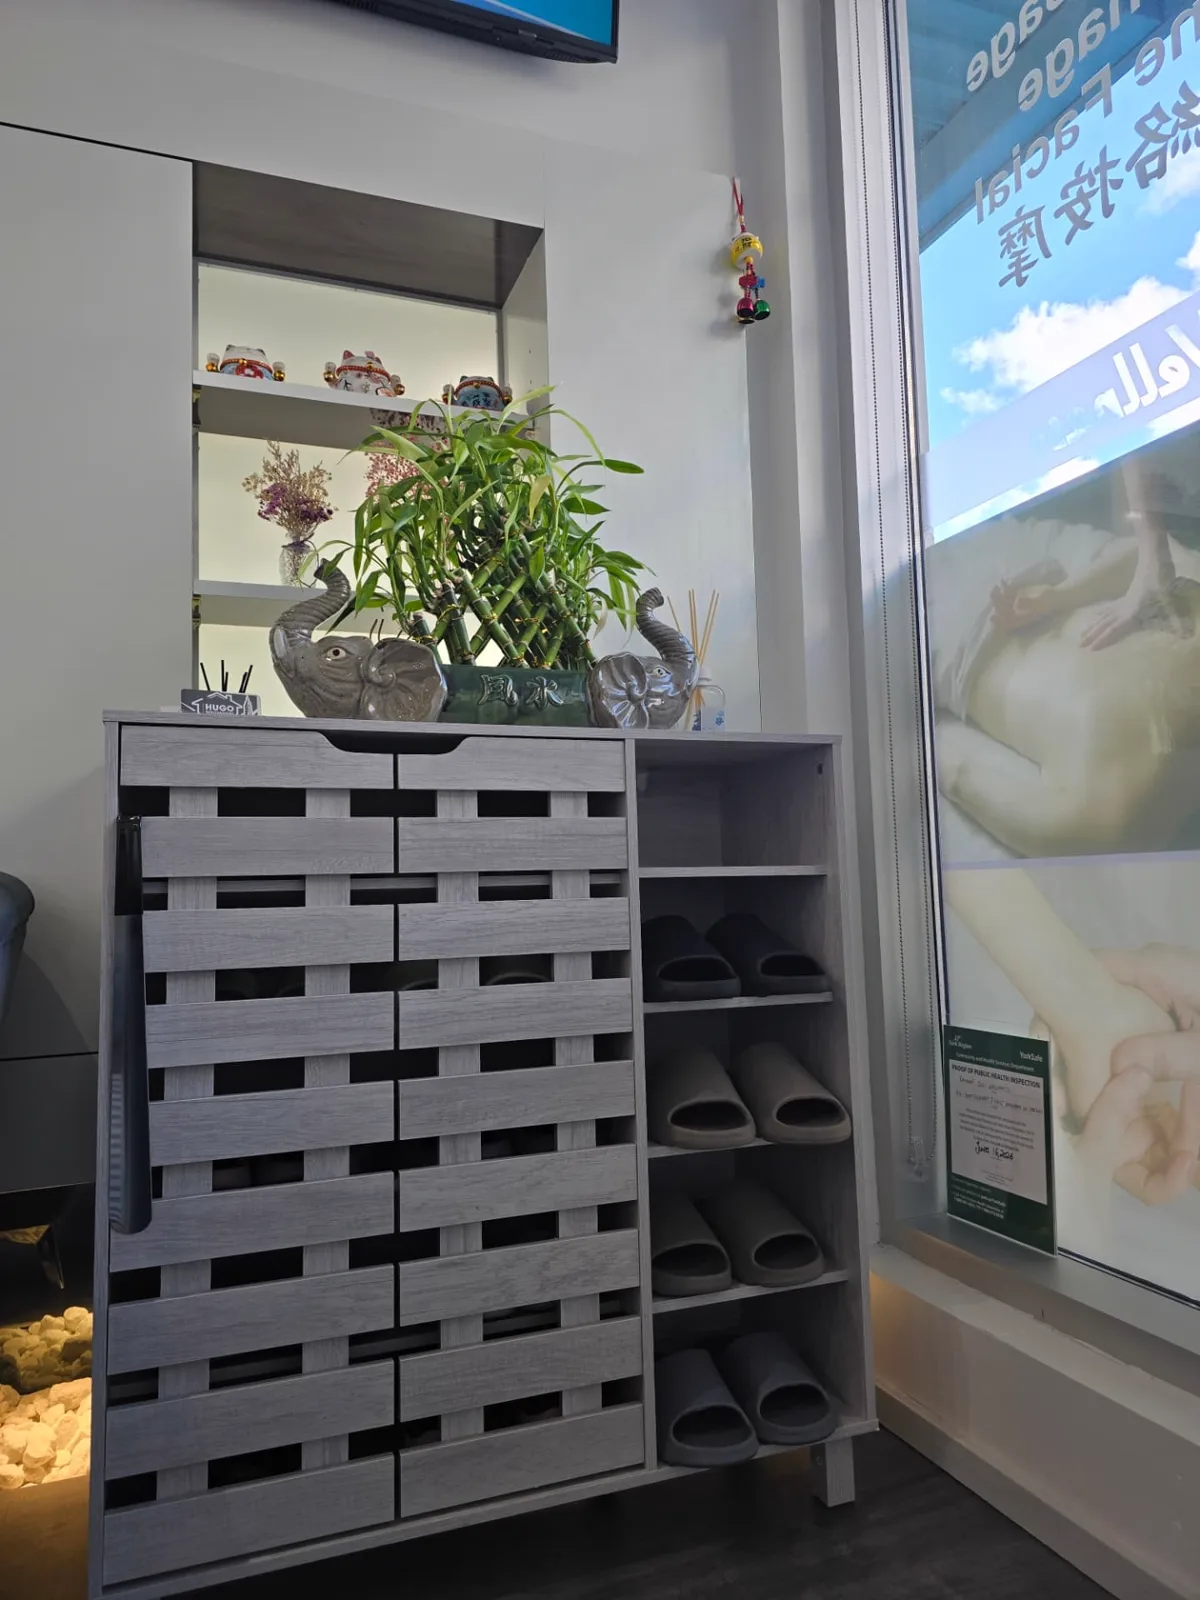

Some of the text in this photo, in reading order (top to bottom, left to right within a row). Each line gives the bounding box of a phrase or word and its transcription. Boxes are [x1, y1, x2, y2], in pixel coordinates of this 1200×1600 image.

[205, 703, 234, 712] HUGO
[952, 1064, 967, 1073] PROOF
[974, 1068, 990, 1078] PUBLIC
[991, 1072, 1010, 1081] HEALTH
[1011, 1076, 1040, 1088] INSPECTION
